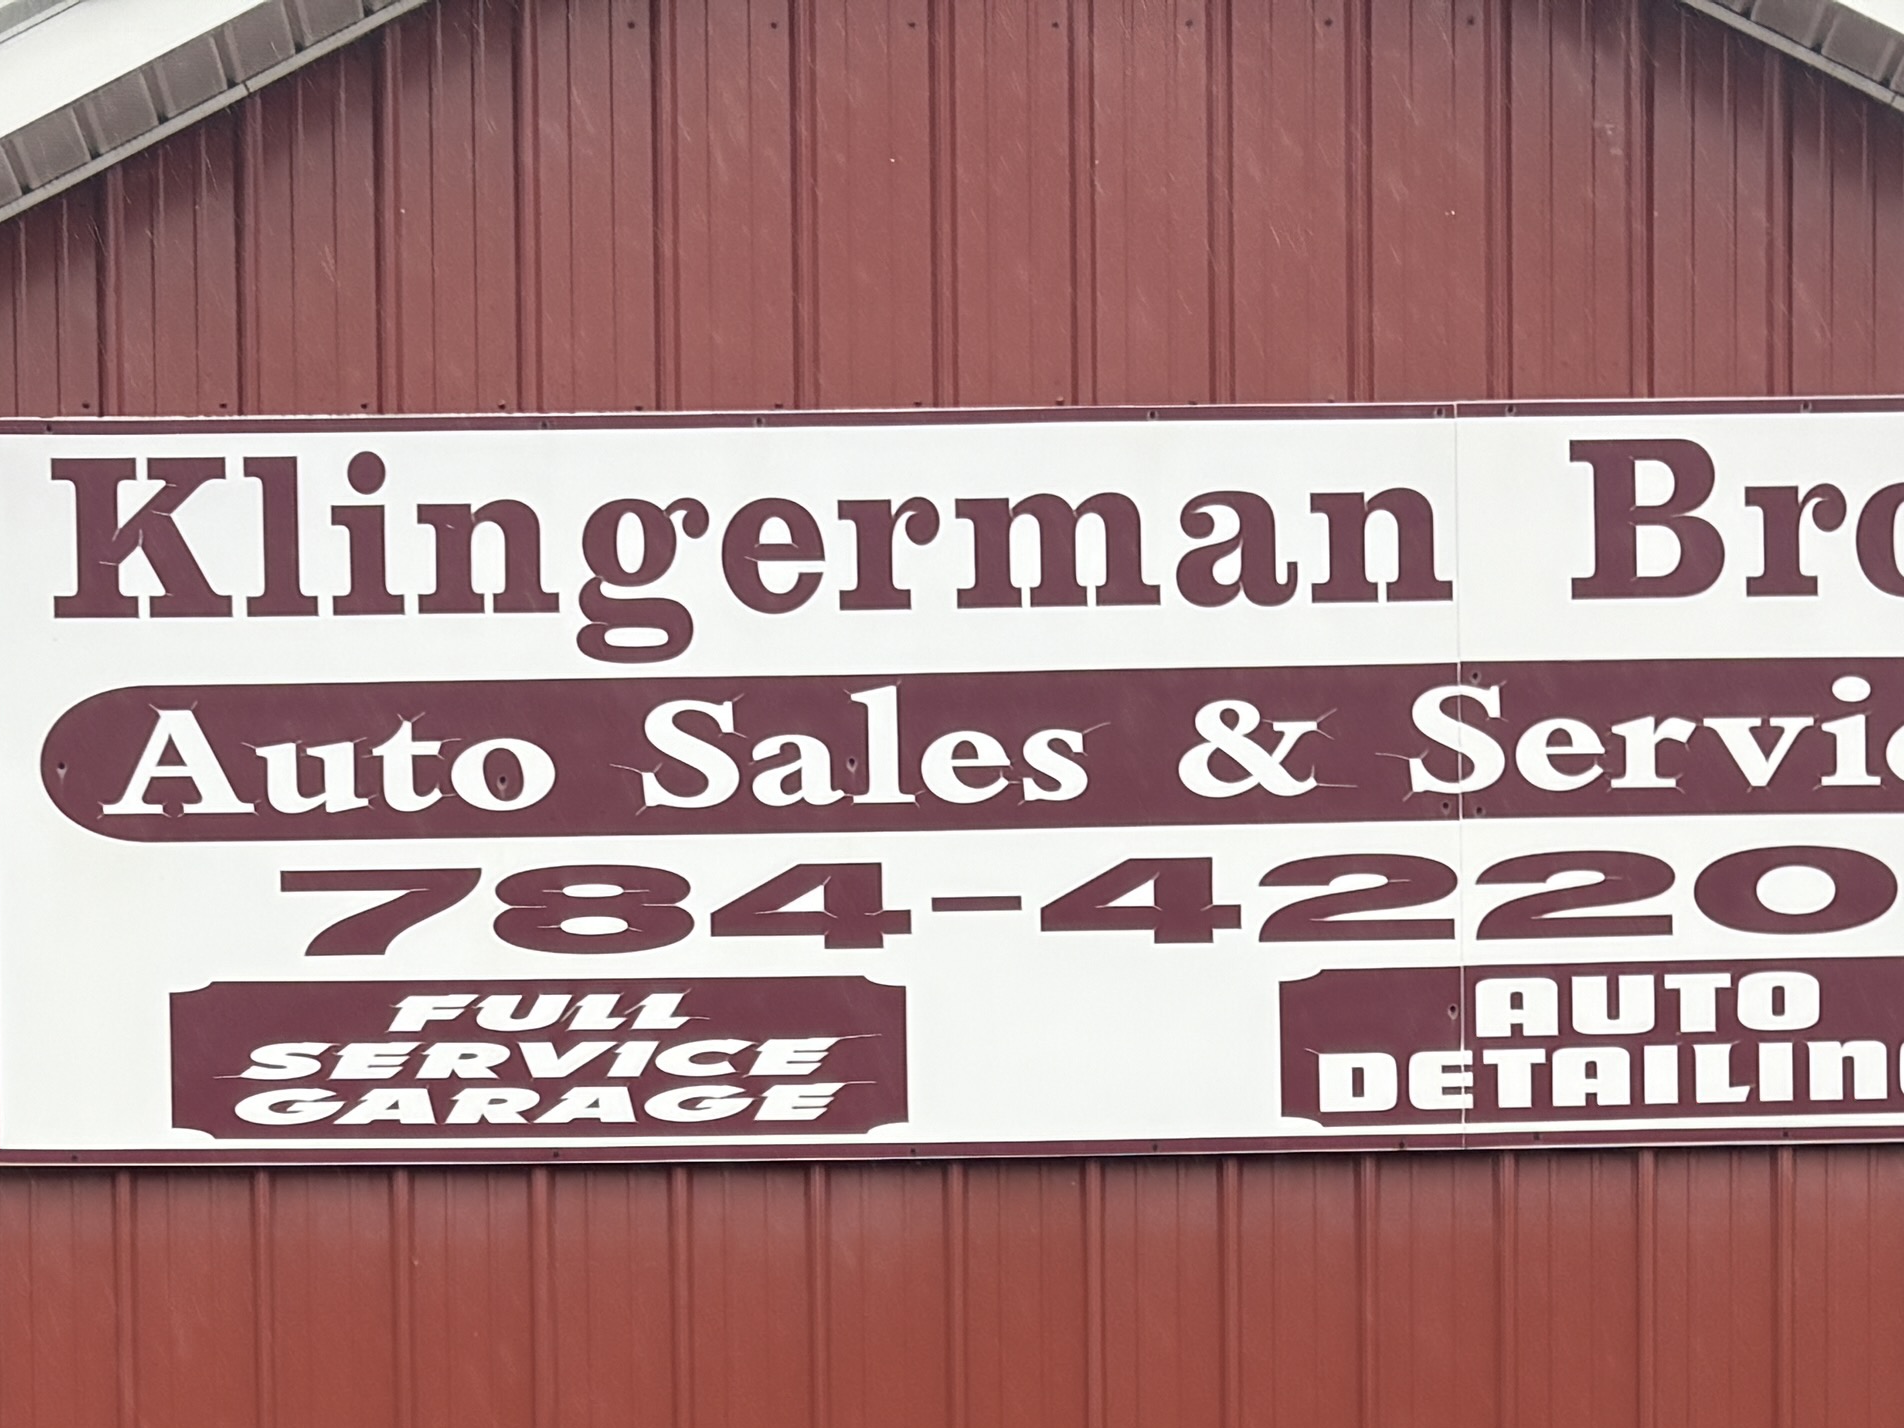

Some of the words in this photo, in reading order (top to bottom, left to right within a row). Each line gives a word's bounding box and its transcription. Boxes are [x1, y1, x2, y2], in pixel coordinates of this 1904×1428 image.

[51, 451, 1454, 664] Klingerman
[103, 709, 556, 815] Auto
[640, 685, 1088, 809] Sales
[1179, 699, 1319, 798] &
[280, 844, 1899, 957] 784-4220
[388, 992, 694, 1032] FULL
[1475, 970, 1820, 1038] AUTO
[238, 1036, 841, 1080] SERVICE
[234, 1082, 848, 1126] GARAGE
